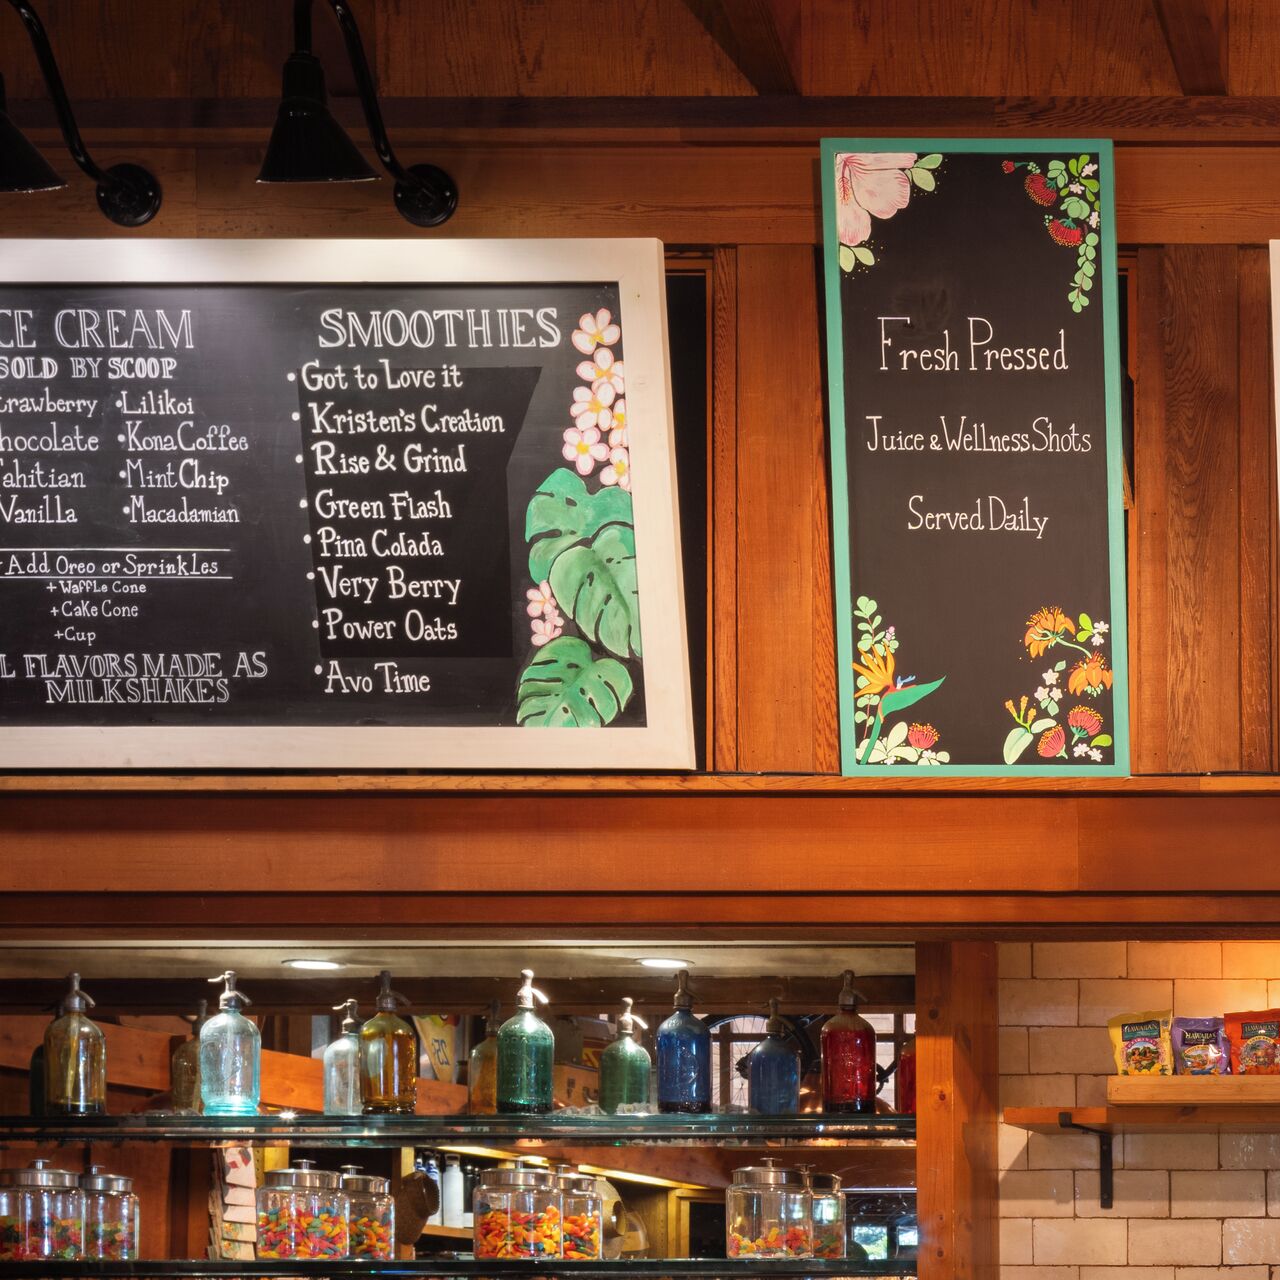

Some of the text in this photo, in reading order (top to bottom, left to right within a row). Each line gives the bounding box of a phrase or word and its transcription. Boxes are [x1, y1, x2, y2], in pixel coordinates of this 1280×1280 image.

[54, 309, 194, 349] CREAM
[318, 307, 562, 348] SMOOTHIES
[877, 316, 1069, 371] Fresh Pressed
[0, 357, 177, 379] SOLD BY SCOOP
[302, 359, 464, 391] Got to Love it
[121, 390, 194, 415] Lilikoi
[308, 402, 506, 434] Kristen's Creation
[866, 416, 924, 451] Juice
[930, 434, 942, 450] &
[1032, 417, 1092, 452] Shots
[311, 442, 468, 475] Rise & Grind
[130, 494, 240, 524] Macadamian
[315, 489, 453, 520] Green Flash
[908, 495, 1049, 539] Served Daily
[317, 526, 444, 558] Pina Colada
[317, 565, 461, 605] Very Berry
[322, 607, 458, 641] Power Oats
[24, 651, 268, 678] FLAVORS MADE AS
[324, 660, 431, 694] Avo Time
[45, 678, 231, 704] MILKSHAKES
